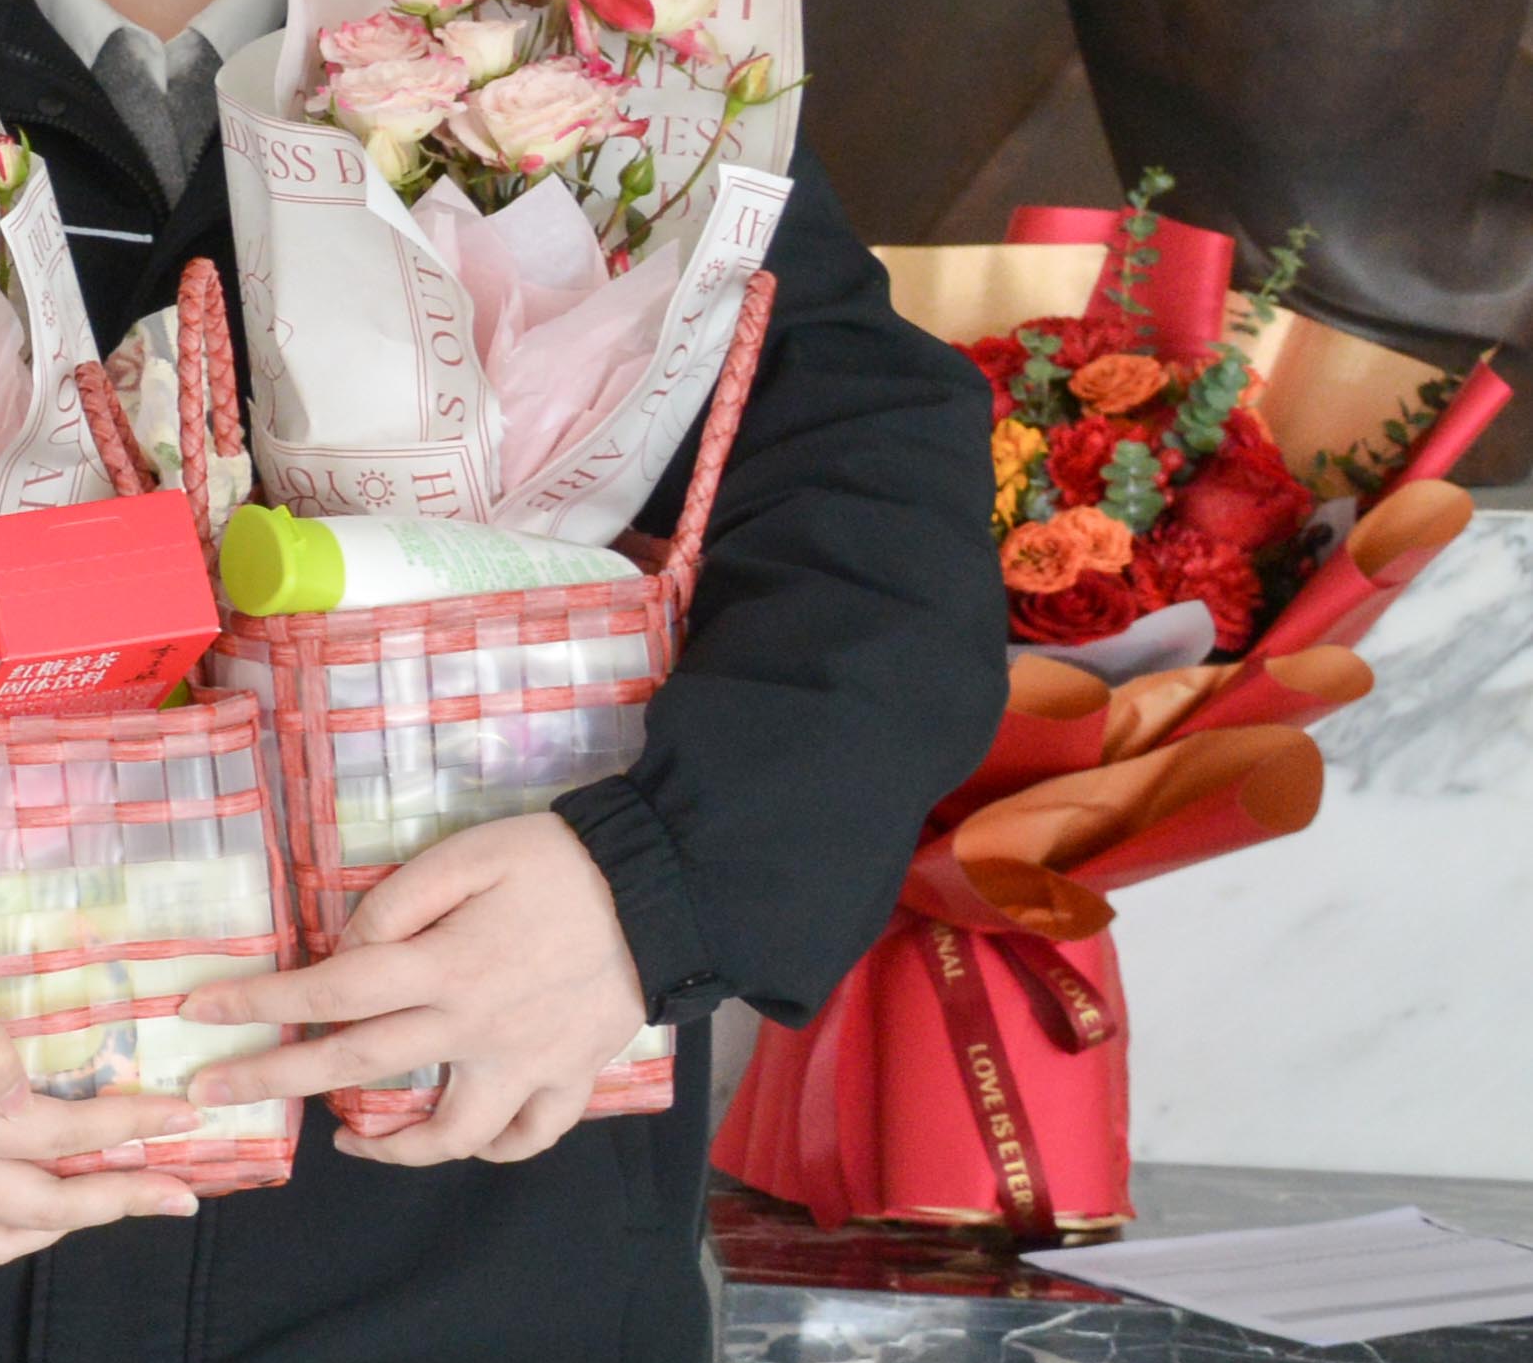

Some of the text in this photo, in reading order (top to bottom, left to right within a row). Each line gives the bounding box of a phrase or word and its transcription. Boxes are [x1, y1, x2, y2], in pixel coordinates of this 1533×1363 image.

[966, 1043, 1036, 1210] LOVE IS ETER
